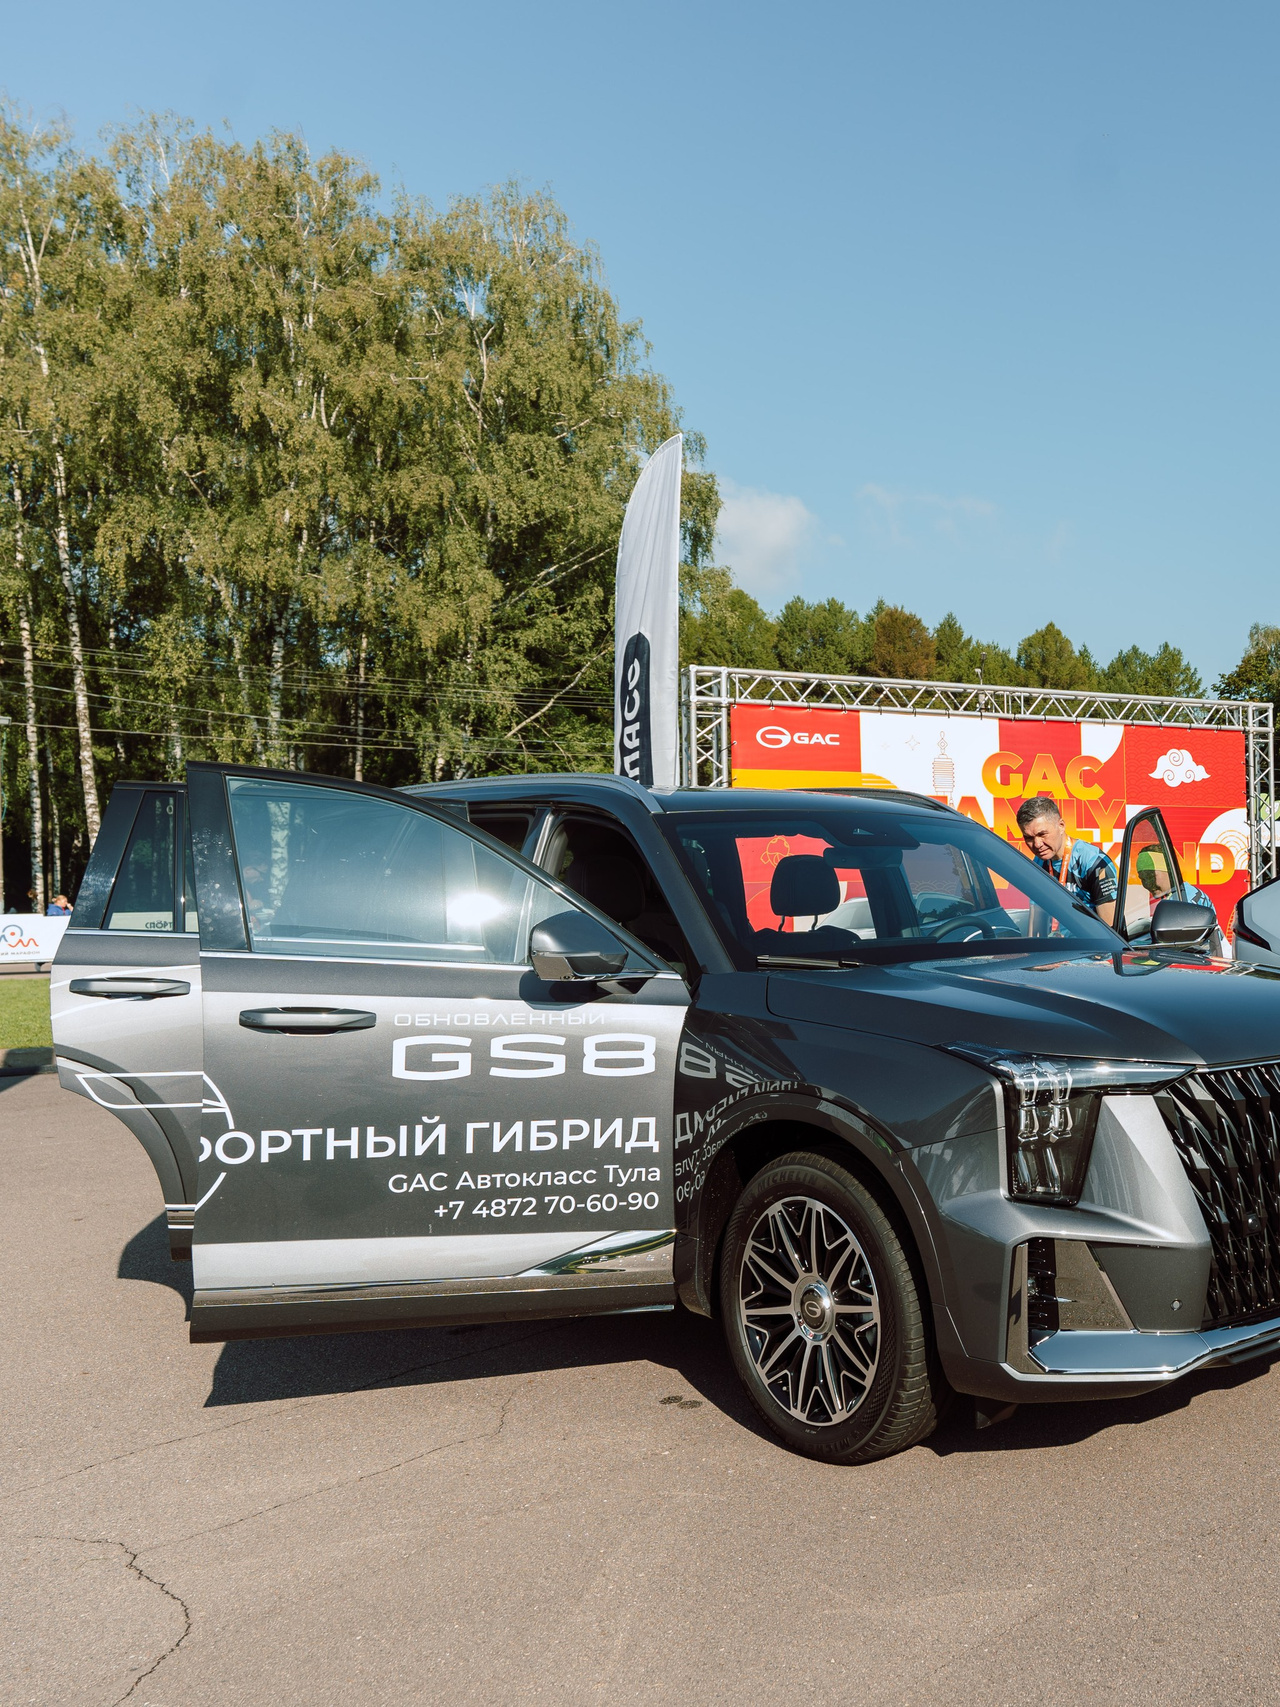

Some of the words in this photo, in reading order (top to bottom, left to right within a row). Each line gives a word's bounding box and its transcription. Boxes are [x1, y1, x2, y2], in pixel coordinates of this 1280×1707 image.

[623, 658, 640, 784] ЛАСС
[793, 732, 840, 746] GAC
[981, 751, 1105, 800] GAC
[392, 1033, 657, 1081] GS8
[465, 1117, 660, 1154] ГИБРИД
[388, 1172, 448, 1194] GAC
[455, 1168, 597, 1190] Автокласс
[603, 1164, 661, 1188] Тула
[434, 1200, 465, 1220] +7
[472, 1197, 538, 1219] 4872
[545, 1191, 660, 1215] 70-60-90
